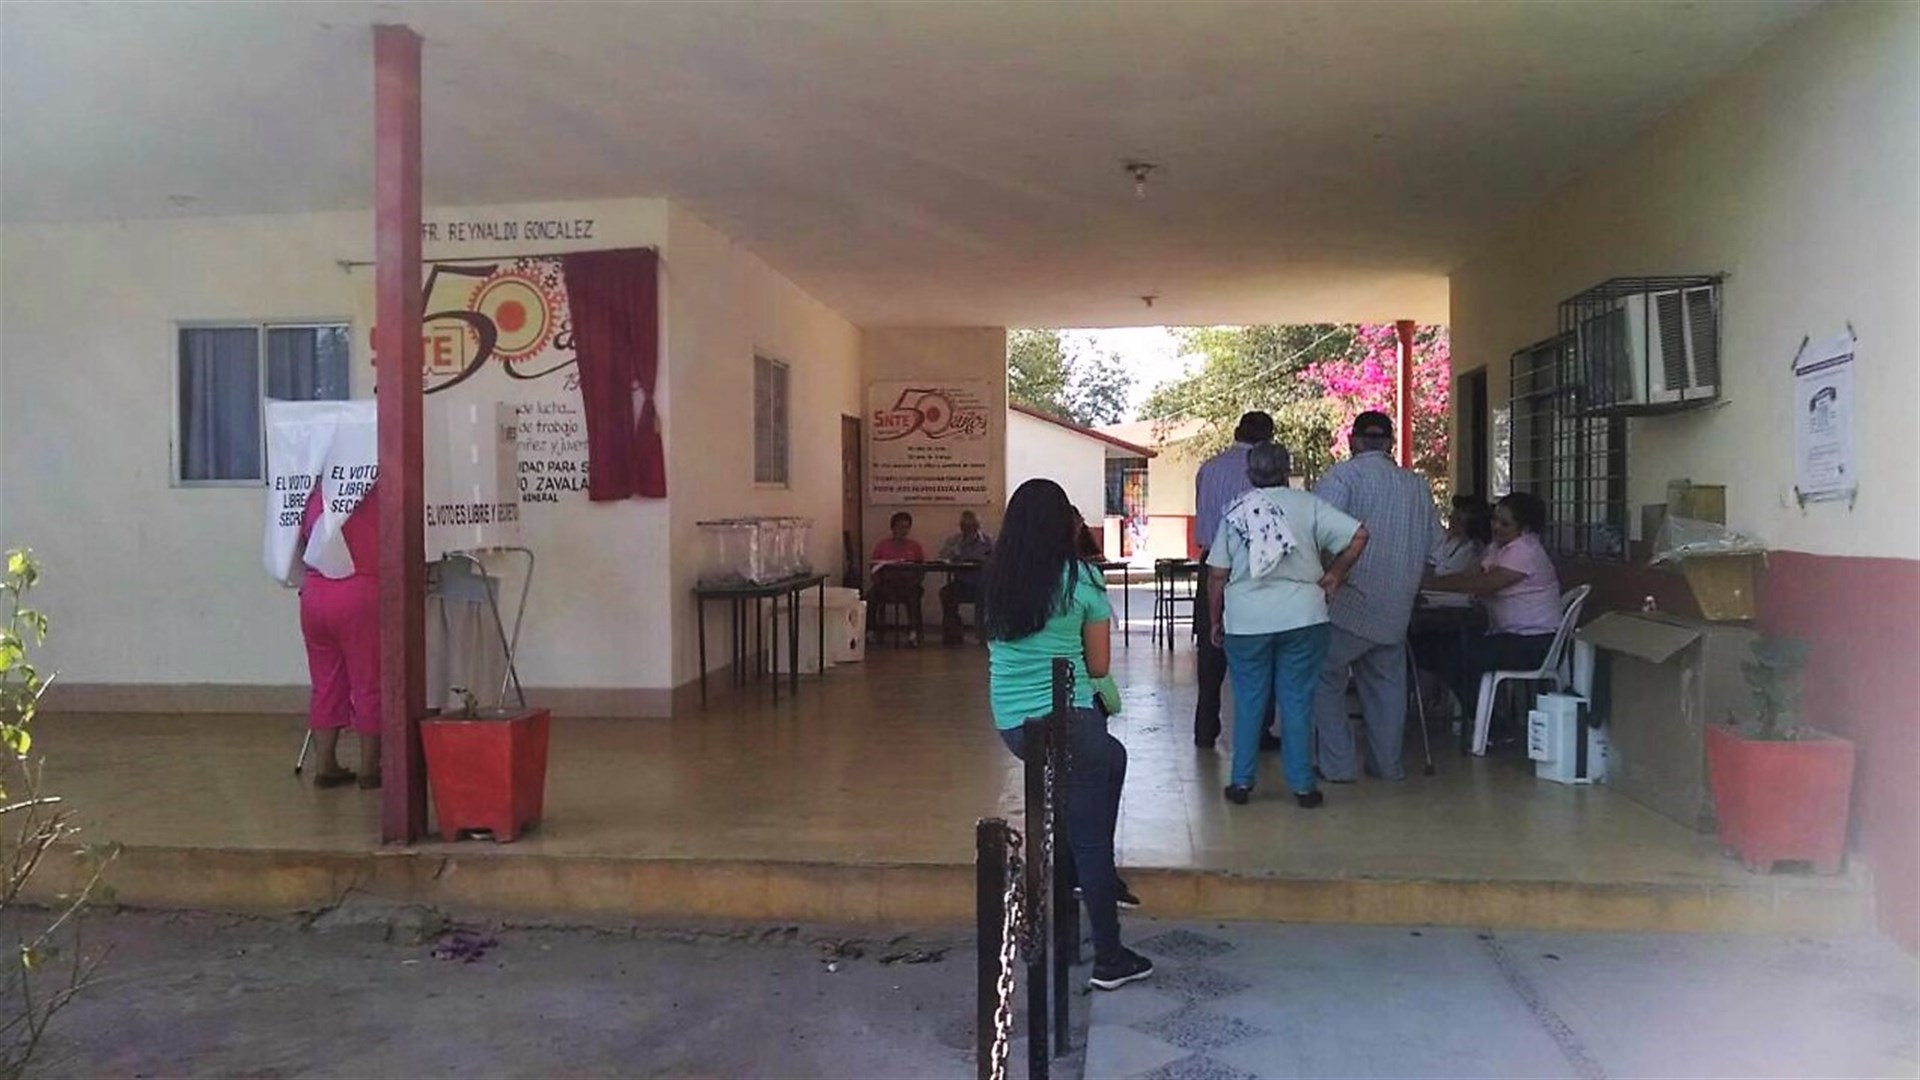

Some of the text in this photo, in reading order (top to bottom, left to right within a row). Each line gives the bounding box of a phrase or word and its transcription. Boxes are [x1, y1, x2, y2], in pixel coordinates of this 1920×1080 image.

[331, 465, 379, 480] EL VOTO
[547, 460, 576, 473] PARA
[276, 476, 287, 491] EL
[289, 475, 311, 490] VOTO
[535, 477, 589, 491] ZAVALA
[427, 504, 436, 526] EL
[437, 504, 455, 526] VOTO
[455, 504, 466, 526] ES
[467, 503, 490, 524] LIBRE
